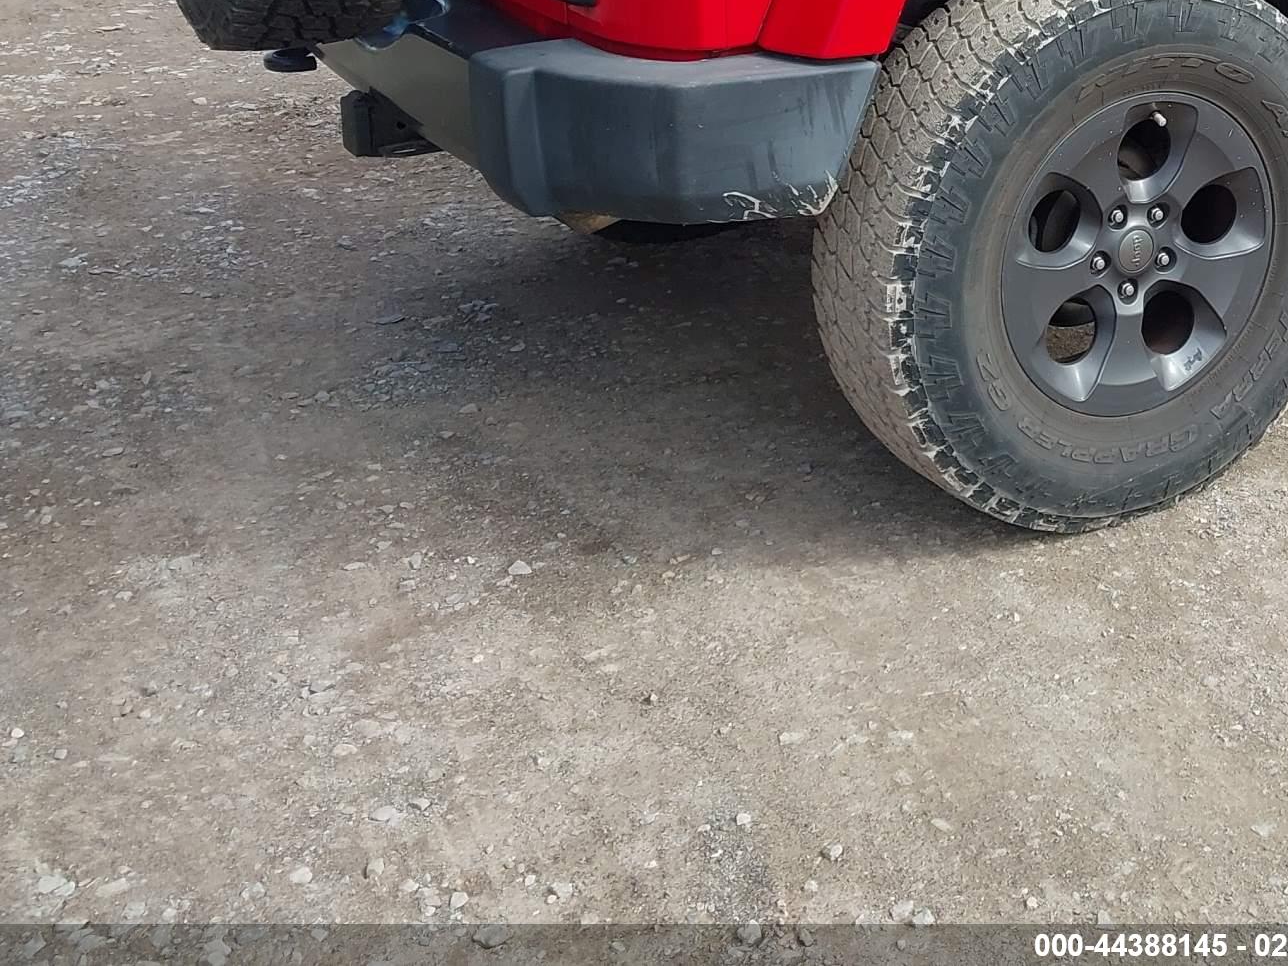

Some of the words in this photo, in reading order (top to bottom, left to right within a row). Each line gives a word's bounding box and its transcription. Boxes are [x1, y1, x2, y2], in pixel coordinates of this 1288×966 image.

[1076, 52, 1255, 103] NITTO
[976, 353, 1009, 412] G2
[1016, 416, 1199, 465] GRAPPLER
